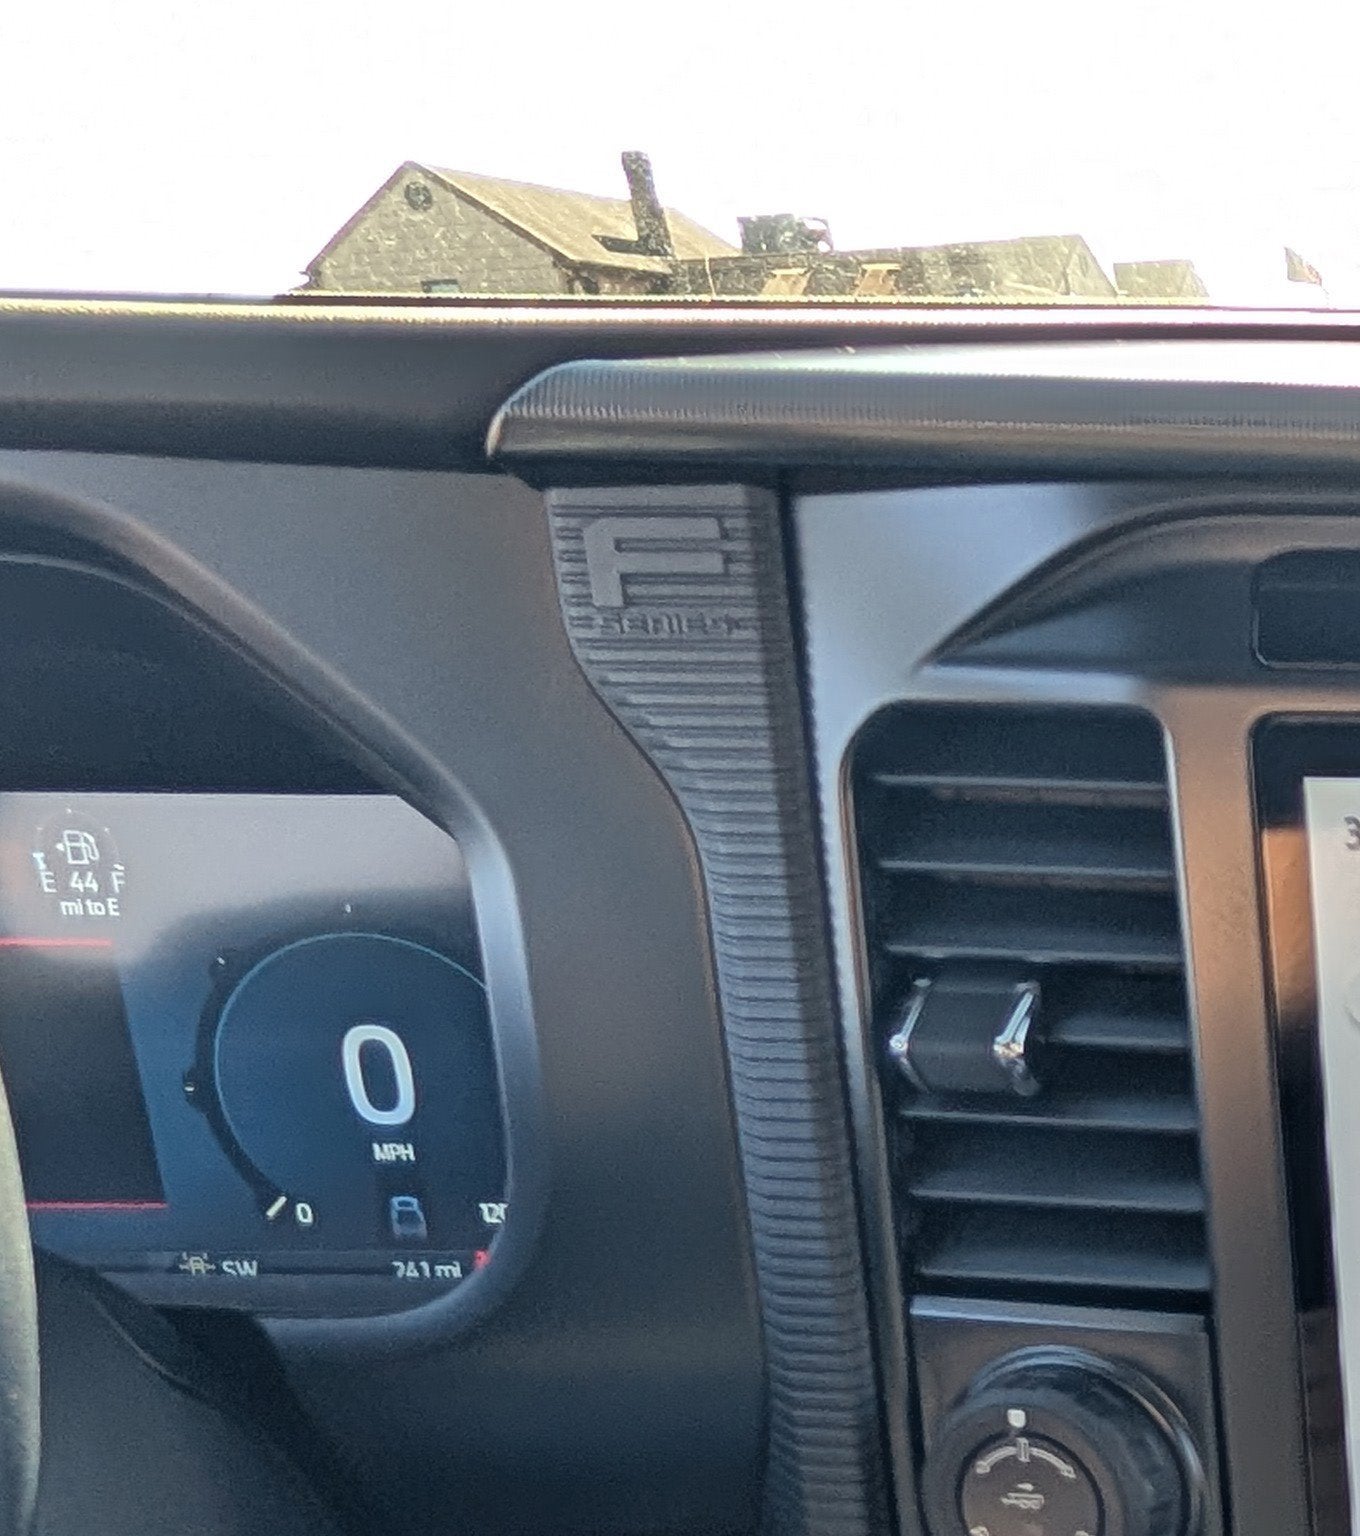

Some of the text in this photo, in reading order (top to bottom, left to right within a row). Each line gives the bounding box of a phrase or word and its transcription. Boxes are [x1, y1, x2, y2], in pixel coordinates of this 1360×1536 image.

[70, 871, 99, 893] 44
[341, 1023, 417, 1126] 0
[372, 1142, 417, 1163] MPH
[222, 1260, 259, 1278] SW
